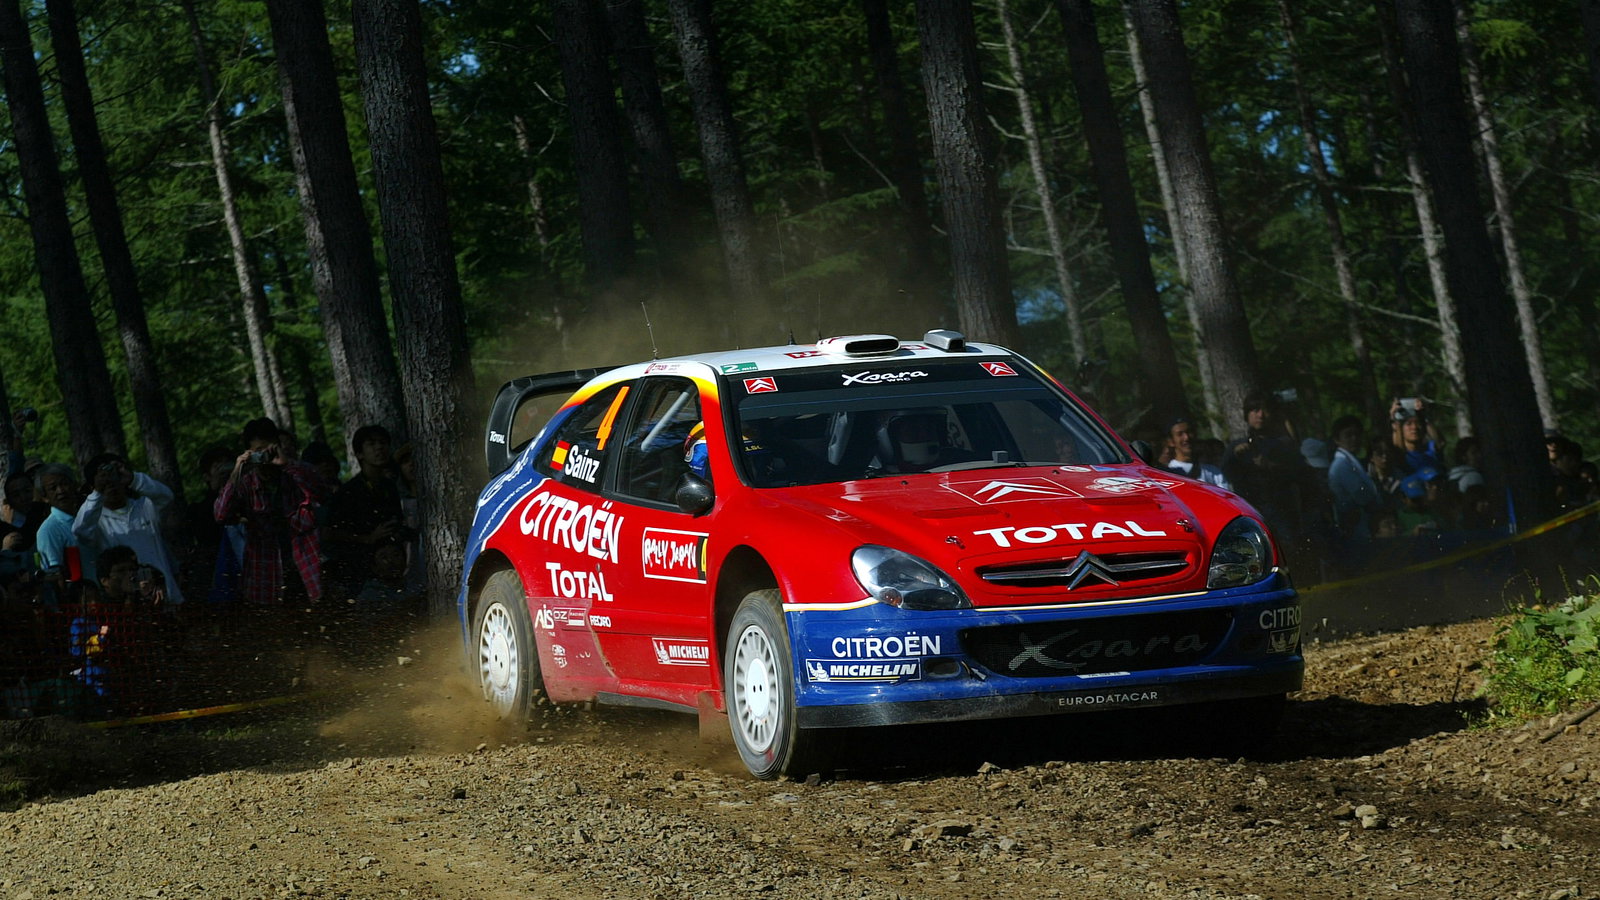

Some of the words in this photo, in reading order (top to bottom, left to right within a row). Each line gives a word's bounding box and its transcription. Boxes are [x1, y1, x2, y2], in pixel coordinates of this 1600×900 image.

[723, 364, 740, 372] 2
[841, 371, 928, 386] Xsara
[596, 386, 630, 450] 4
[490, 431, 505, 444] TOTAL
[565, 444, 600, 484] Sainz
[520, 491, 624, 564] CITROËN
[973, 521, 1166, 547] TOTAL
[546, 562, 614, 602] TOTAL
[553, 611, 568, 620] OZ
[831, 631, 941, 658] CITROËN
[1008, 629, 1209, 672] Xsara
[830, 664, 917, 676] MICHELIN
[1059, 691, 1158, 706] EURODATACAR
